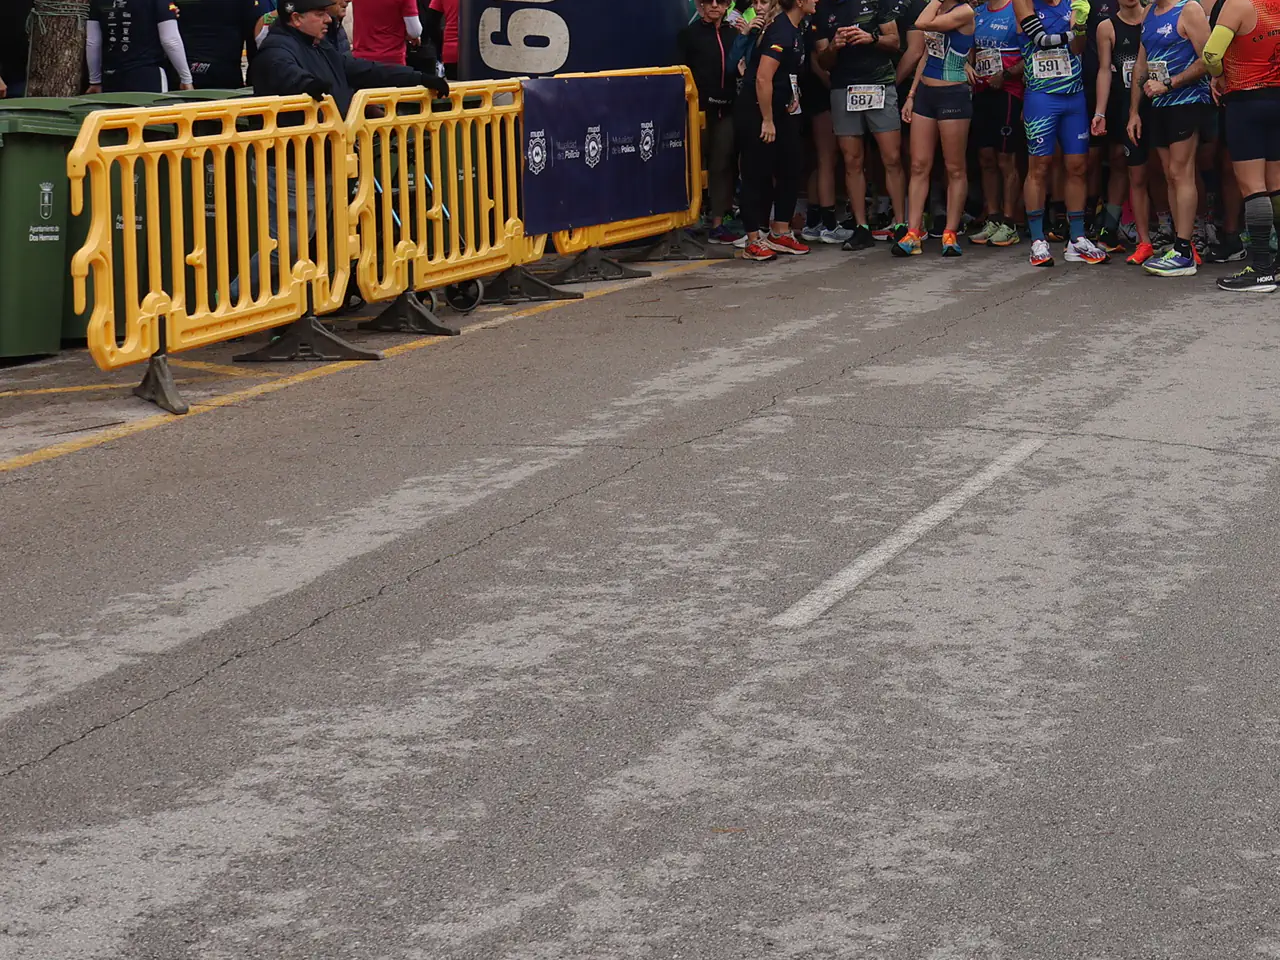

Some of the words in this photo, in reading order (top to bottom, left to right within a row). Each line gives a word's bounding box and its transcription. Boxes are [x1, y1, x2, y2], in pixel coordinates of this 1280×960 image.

[1039, 60, 1060, 72] 591
[850, 94, 874, 106] 687
[588, 124, 601, 133] mupol
[530, 129, 545, 138] mupol
[1256, 275, 1274, 283] HOKA
